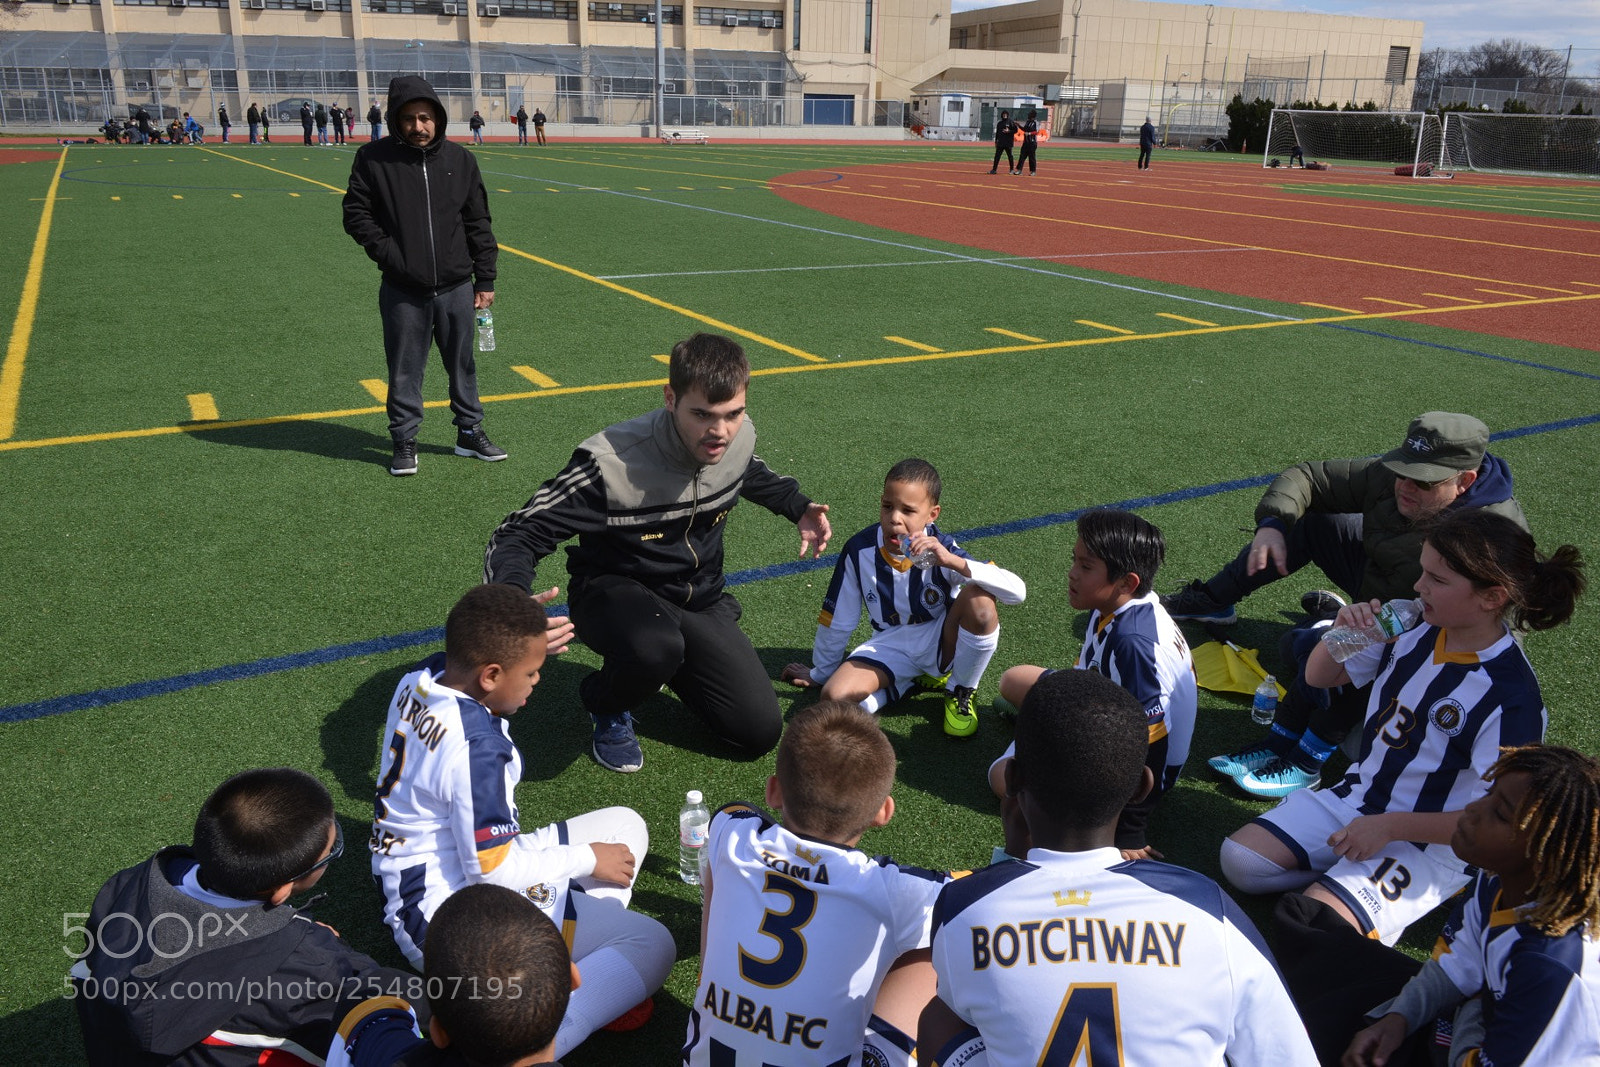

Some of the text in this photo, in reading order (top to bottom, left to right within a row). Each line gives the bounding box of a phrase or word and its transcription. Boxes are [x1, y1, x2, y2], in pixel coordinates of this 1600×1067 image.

[1374, 698, 1417, 750] 13
[761, 849, 829, 885] TOMA
[1367, 857, 1412, 902] 13
[738, 871, 819, 989] 3
[971, 918, 1187, 970] BOTCHWAY
[703, 981, 829, 1049] ALBA FC
